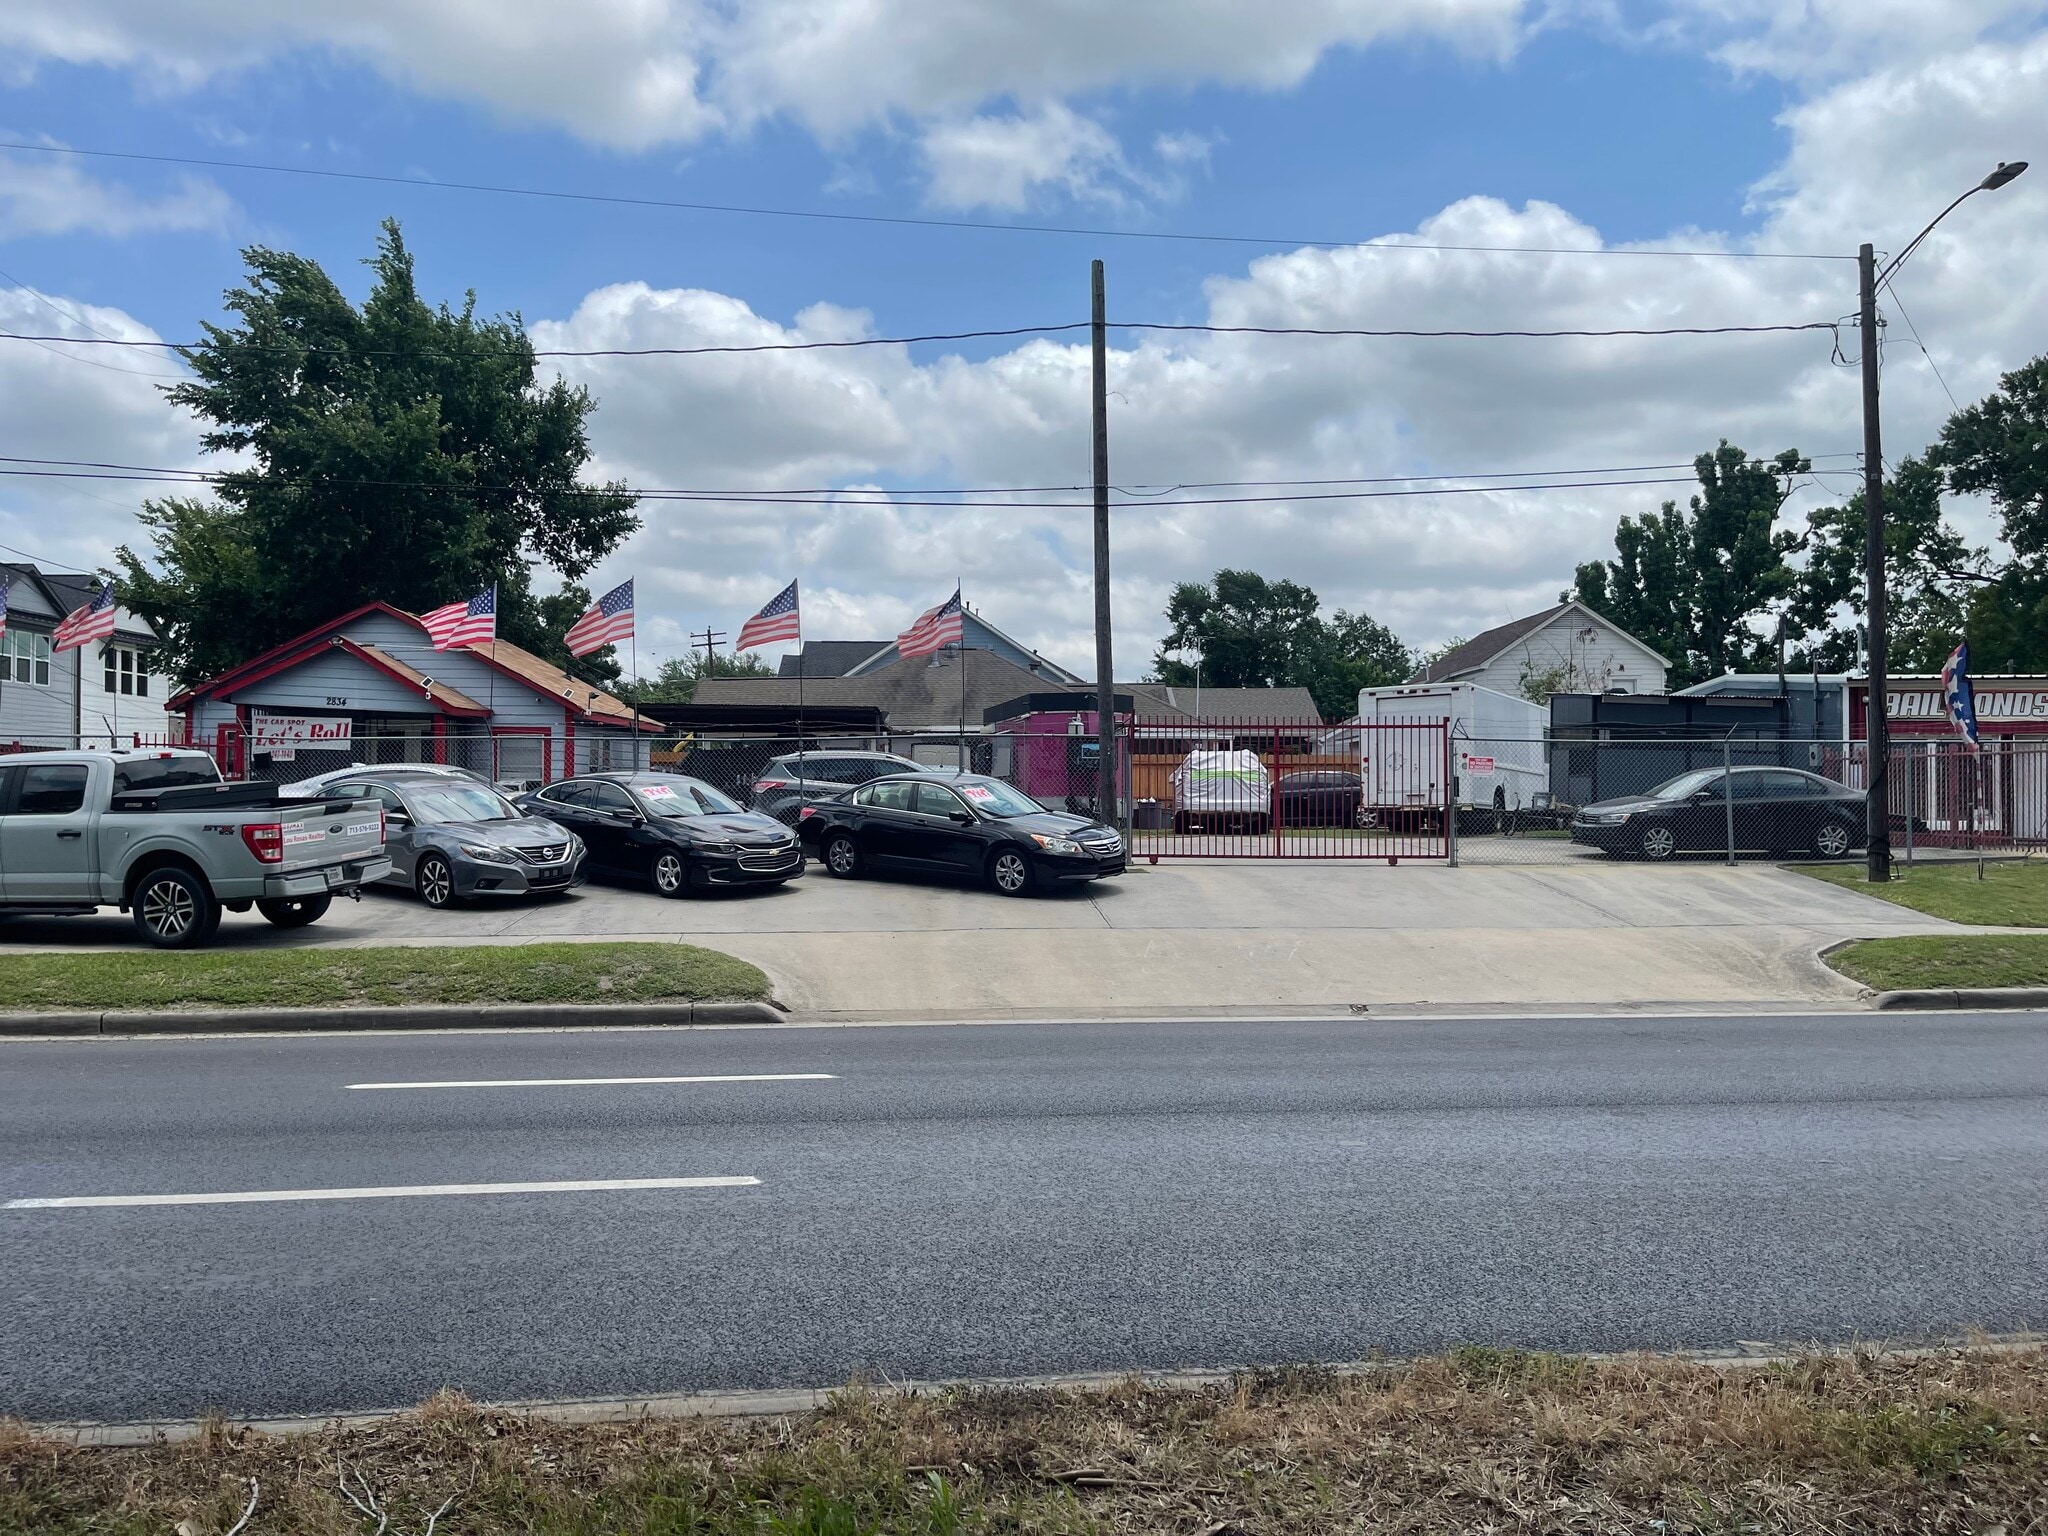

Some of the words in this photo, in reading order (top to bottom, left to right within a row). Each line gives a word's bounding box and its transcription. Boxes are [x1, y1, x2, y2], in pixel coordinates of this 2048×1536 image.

[326, 697, 347, 706] 2834
[1887, 692, 1946, 718] BAIL
[1974, 692, 2048, 718] ONDS
[255, 726, 303, 746] Let's
[308, 722, 350, 743] Roll
[284, 835, 293, 843] Lou
